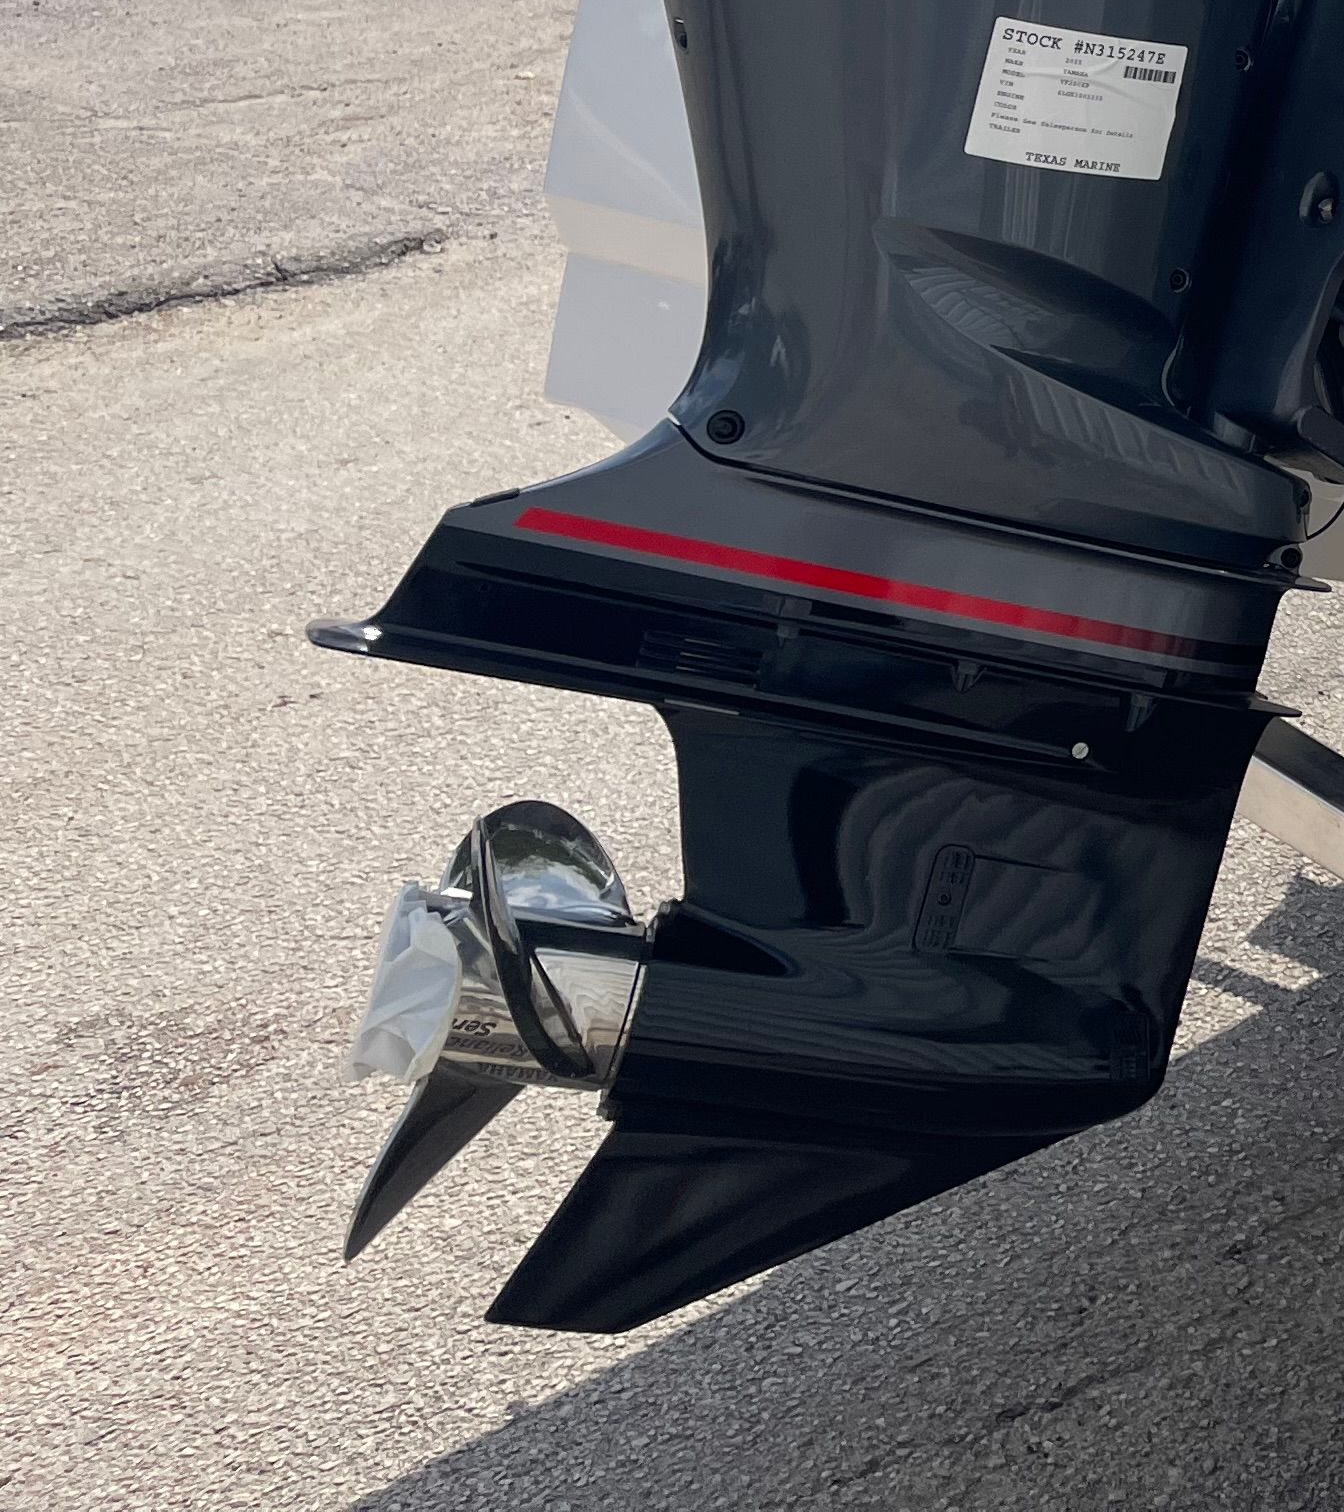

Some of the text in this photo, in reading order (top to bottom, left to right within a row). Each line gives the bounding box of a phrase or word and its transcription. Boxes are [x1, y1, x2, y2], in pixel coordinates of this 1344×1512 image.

[1002, 28, 1167, 65] STOCK #N315247E
[1025, 151, 1121, 173] TEXAS MARINE
